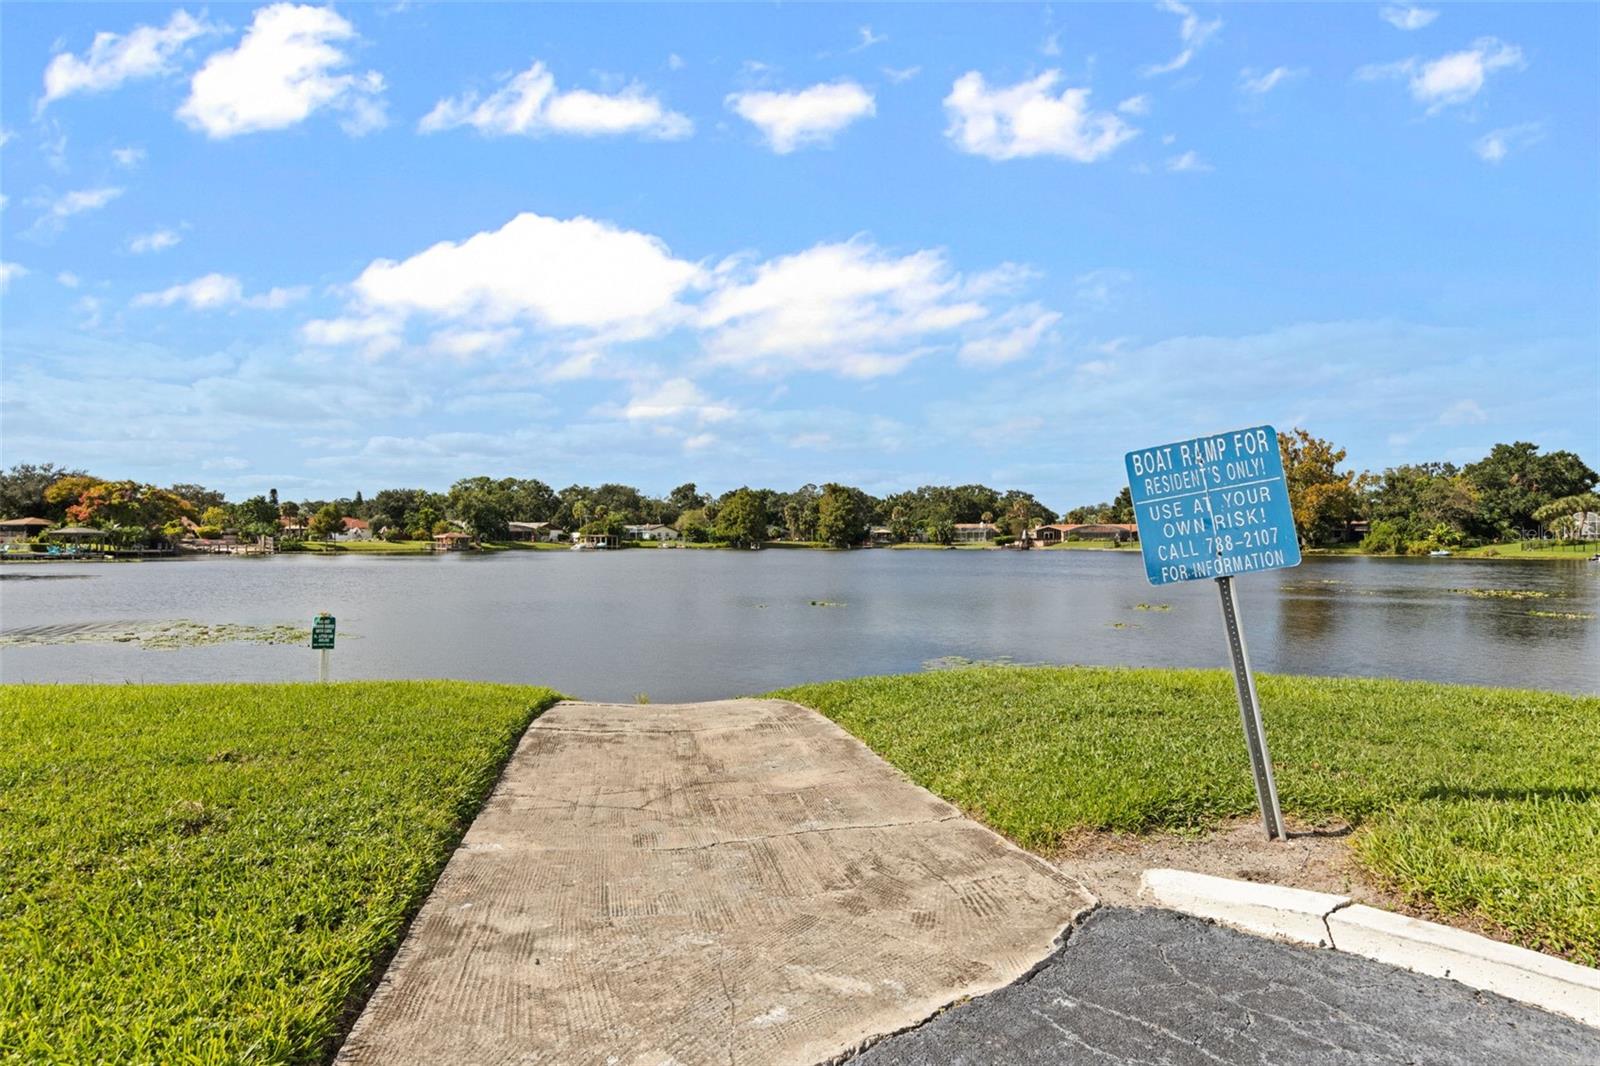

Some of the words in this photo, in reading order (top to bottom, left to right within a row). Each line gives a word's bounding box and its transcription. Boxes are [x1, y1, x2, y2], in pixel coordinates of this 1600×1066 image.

[1133, 448, 1173, 476] BOAT
[1181, 438, 1226, 467] RAMP
[1234, 430, 1269, 457] FOR
[1228, 458, 1265, 480] ONLY!
[1150, 502, 1183, 520] USE
[1194, 497, 1211, 513] AT
[1223, 487, 1271, 508] YOUR
[1164, 518, 1205, 538] OWN
[1214, 508, 1265, 530] RISK!
[1158, 540, 1199, 561] CALL
[1206, 527, 1278, 553] 788-2107
[1162, 565, 1187, 582] FOR
[1193, 549, 1284, 576] INFORMATION
